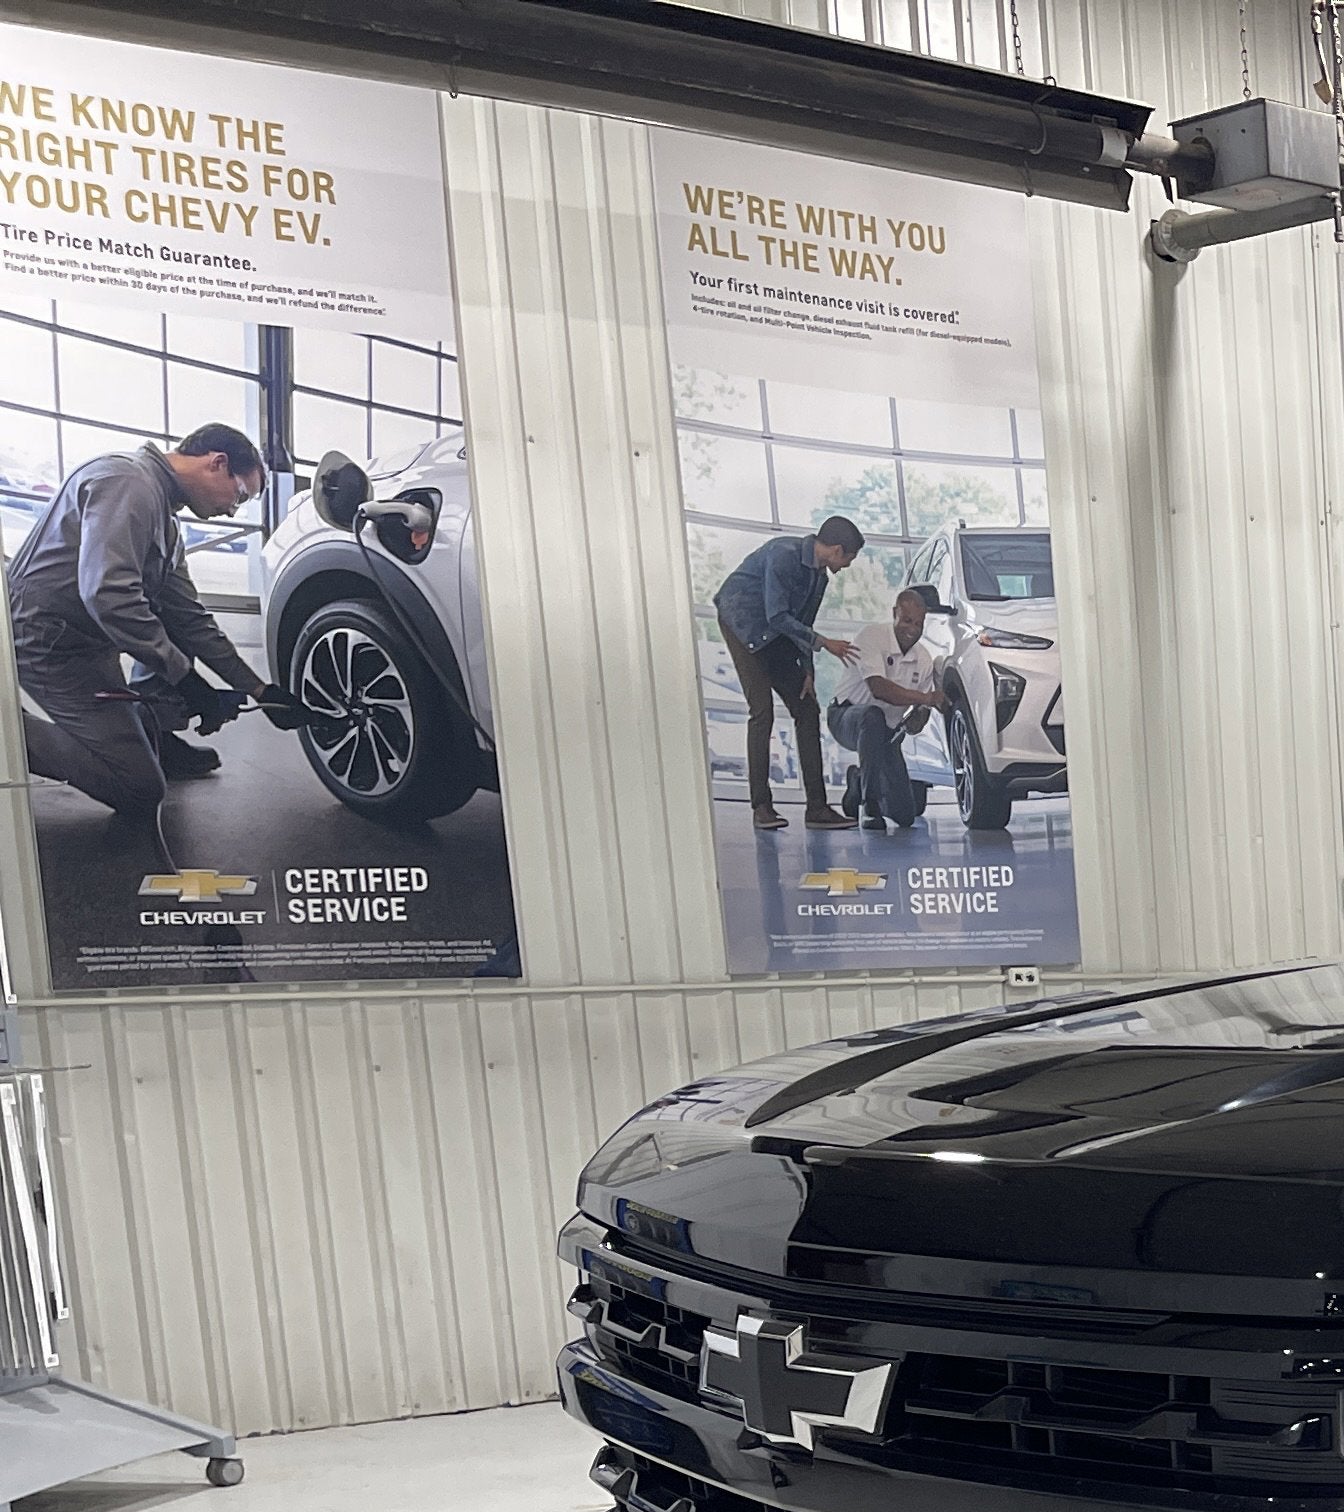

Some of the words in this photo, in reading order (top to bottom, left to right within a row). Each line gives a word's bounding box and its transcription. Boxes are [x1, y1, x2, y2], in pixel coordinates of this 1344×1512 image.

[70, 92, 195, 143] KNOW
[208, 113, 286, 155] THE
[0, 125, 119, 176] RIGHT
[131, 146, 249, 193] TIRES
[263, 164, 336, 205] FOR
[0, 170, 111, 219] YOUR
[124, 189, 258, 237] CHEVY
[273, 208, 331, 247] EV.
[683, 183, 786, 230] WE'RE
[796, 202, 877, 245] WITH
[886, 218, 946, 255] YOU
[1, 223, 38, 242] Tire
[44, 229, 93, 250] Price
[99, 237, 154, 260] Match
[160, 246, 257, 272] Guarantee.
[688, 223, 749, 261] ALL
[758, 235, 820, 273] THE
[828, 246, 902, 286] WAY.
[3, 250, 42, 264] Provide
[44, 257, 55, 265] us
[58, 258, 80, 269] with
[91, 262, 121, 274] better
[161, 272, 184, 284] price
[187, 275, 196, 284] at
[199, 276, 214, 286] the
[216, 278, 237, 289] time
[239, 280, 248, 289] of
[251, 283, 295, 296] purchase,
[297, 288, 314, 297] and
[339, 293, 366, 303] match
[4, 262, 26, 274] Find
[37, 267, 68, 280] better
[72, 272, 96, 283] price
[99, 277, 129, 288] within
[131, 280, 143, 290] 30
[146, 282, 167, 294] days
[170, 285, 179, 294] of
[182, 286, 197, 296] the
[200, 289, 245, 302] purchase,
[247, 294, 263, 303] and
[289, 299, 318, 310] refund
[321, 301, 335, 311] the
[689, 271, 723, 289] Your
[727, 277, 759, 296] first
[763, 286, 853, 311] maintenance
[856, 298, 885, 315] visit
[889, 302, 900, 317] is
[285, 867, 429, 894] CERTIFIED
[907, 865, 1014, 889] CERTIFIED
[139, 910, 267, 926] CHEVROLET
[288, 898, 408, 923] SERVICE
[797, 903, 894, 917] CHEVROLET
[910, 892, 999, 915] SERVICE
